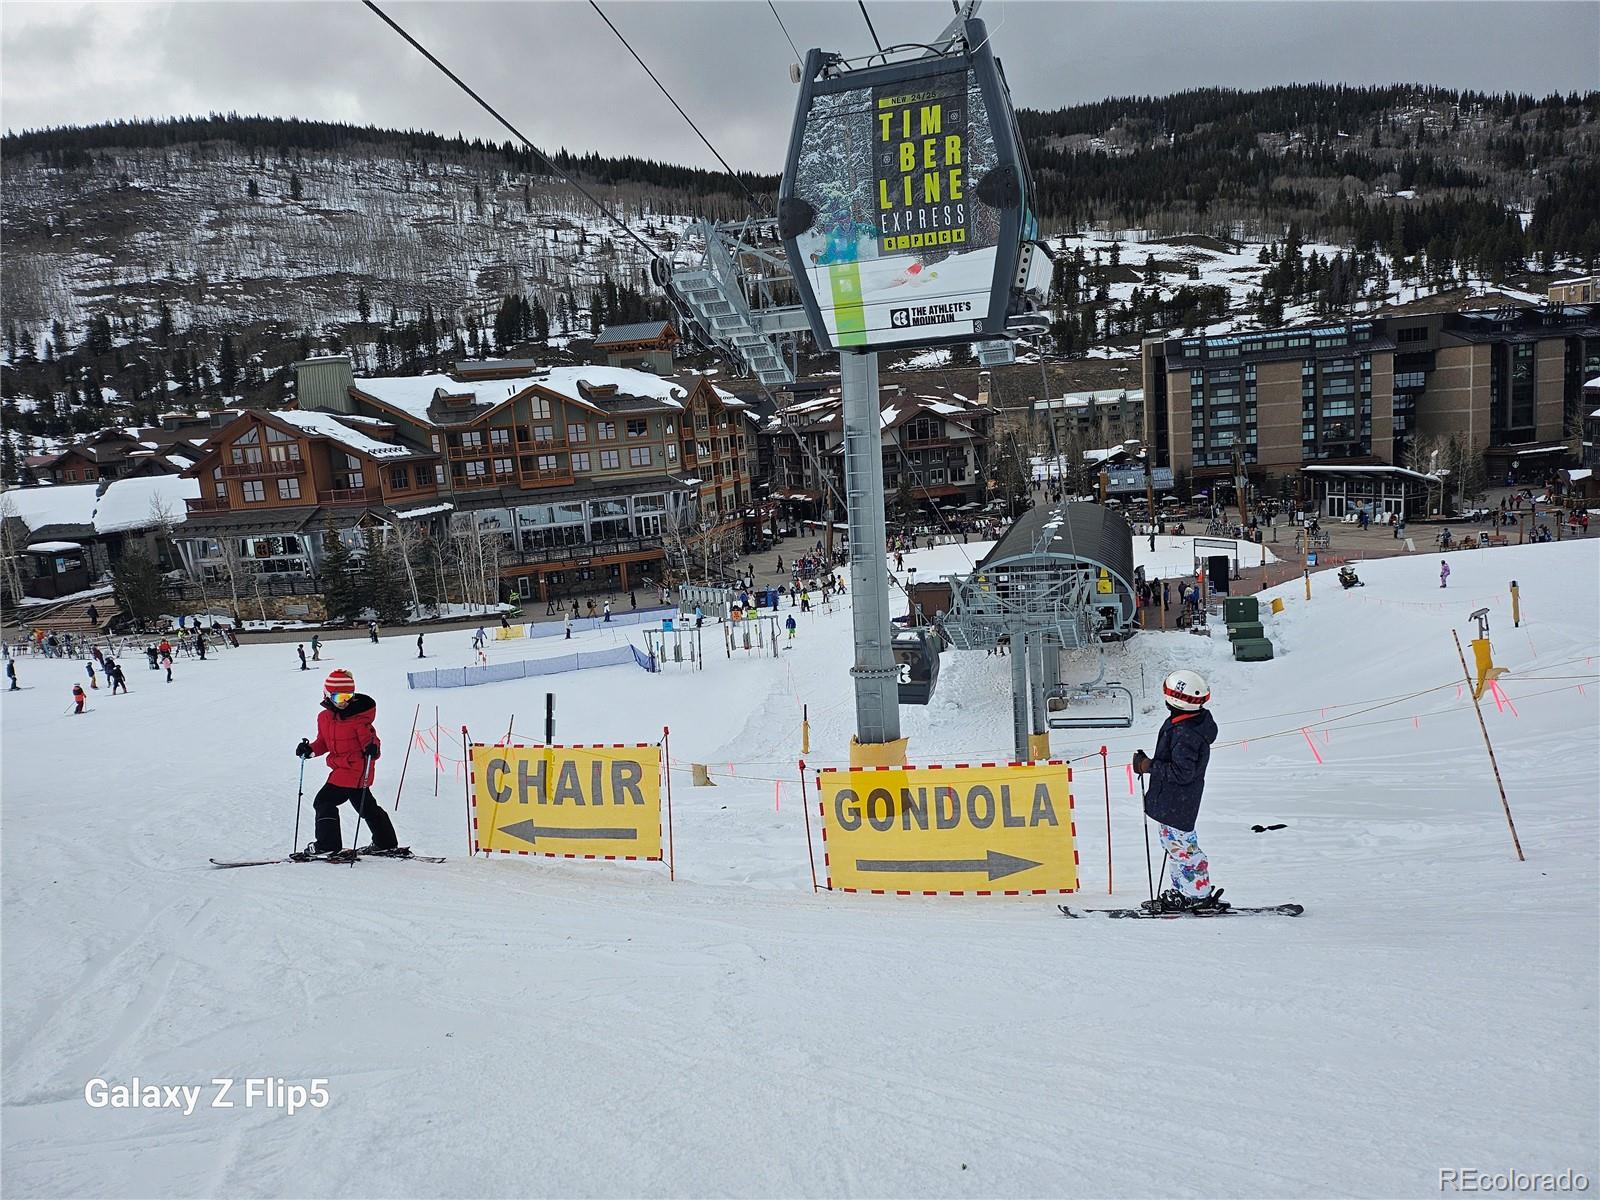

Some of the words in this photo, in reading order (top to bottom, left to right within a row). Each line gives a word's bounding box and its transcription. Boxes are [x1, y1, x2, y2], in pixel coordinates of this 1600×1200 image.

[891, 96, 907, 105] NEW
[878, 104, 941, 142] TIM
[899, 134, 962, 172] BER
[879, 168, 963, 210] LINE
[881, 203, 964, 234] EXPRESS
[886, 231, 962, 249] 6-PACK
[911, 306, 927, 317] THE
[928, 301, 972, 315] ATHLETE'S
[912, 313, 955, 327] MOUNTAIN
[486, 758, 645, 806] CHAIR
[834, 783, 1059, 832] GONDOLA
